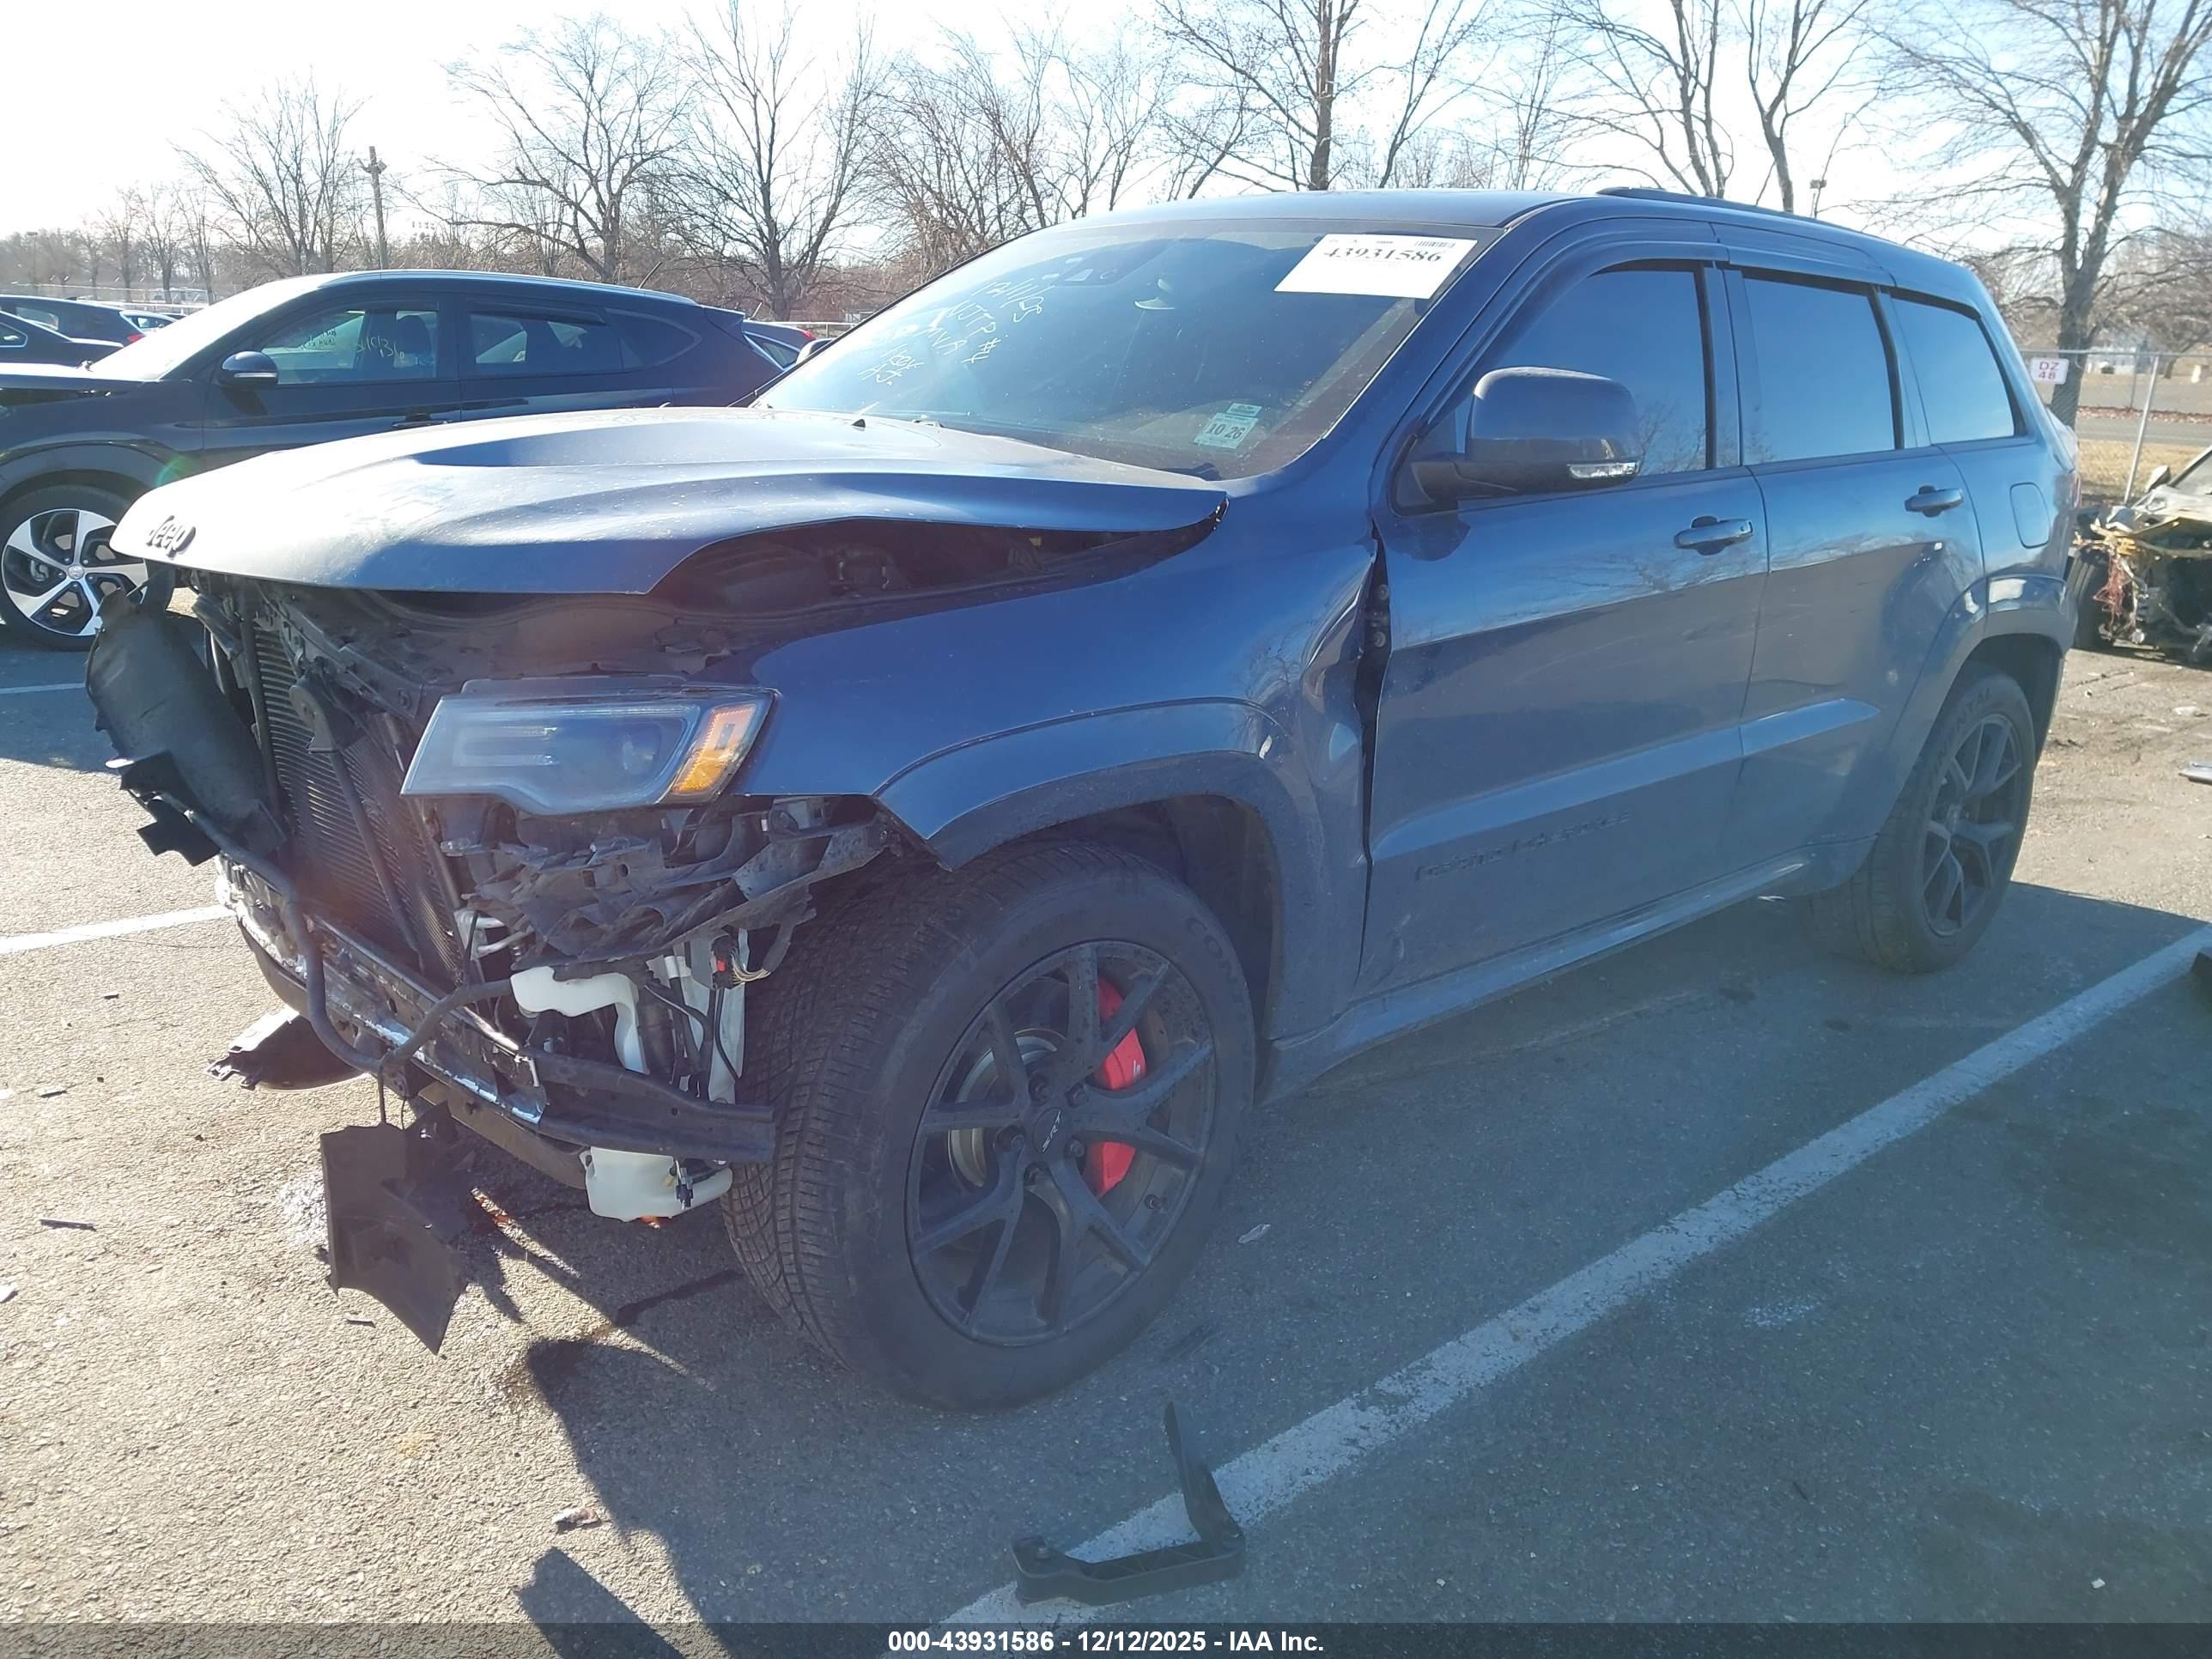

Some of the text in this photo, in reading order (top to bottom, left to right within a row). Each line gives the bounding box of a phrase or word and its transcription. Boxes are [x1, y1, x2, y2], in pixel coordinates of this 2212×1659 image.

[1324, 247, 1444, 262] 43931586
[1204, 423, 1227, 435] 10
[145, 514, 197, 561] Jeep
